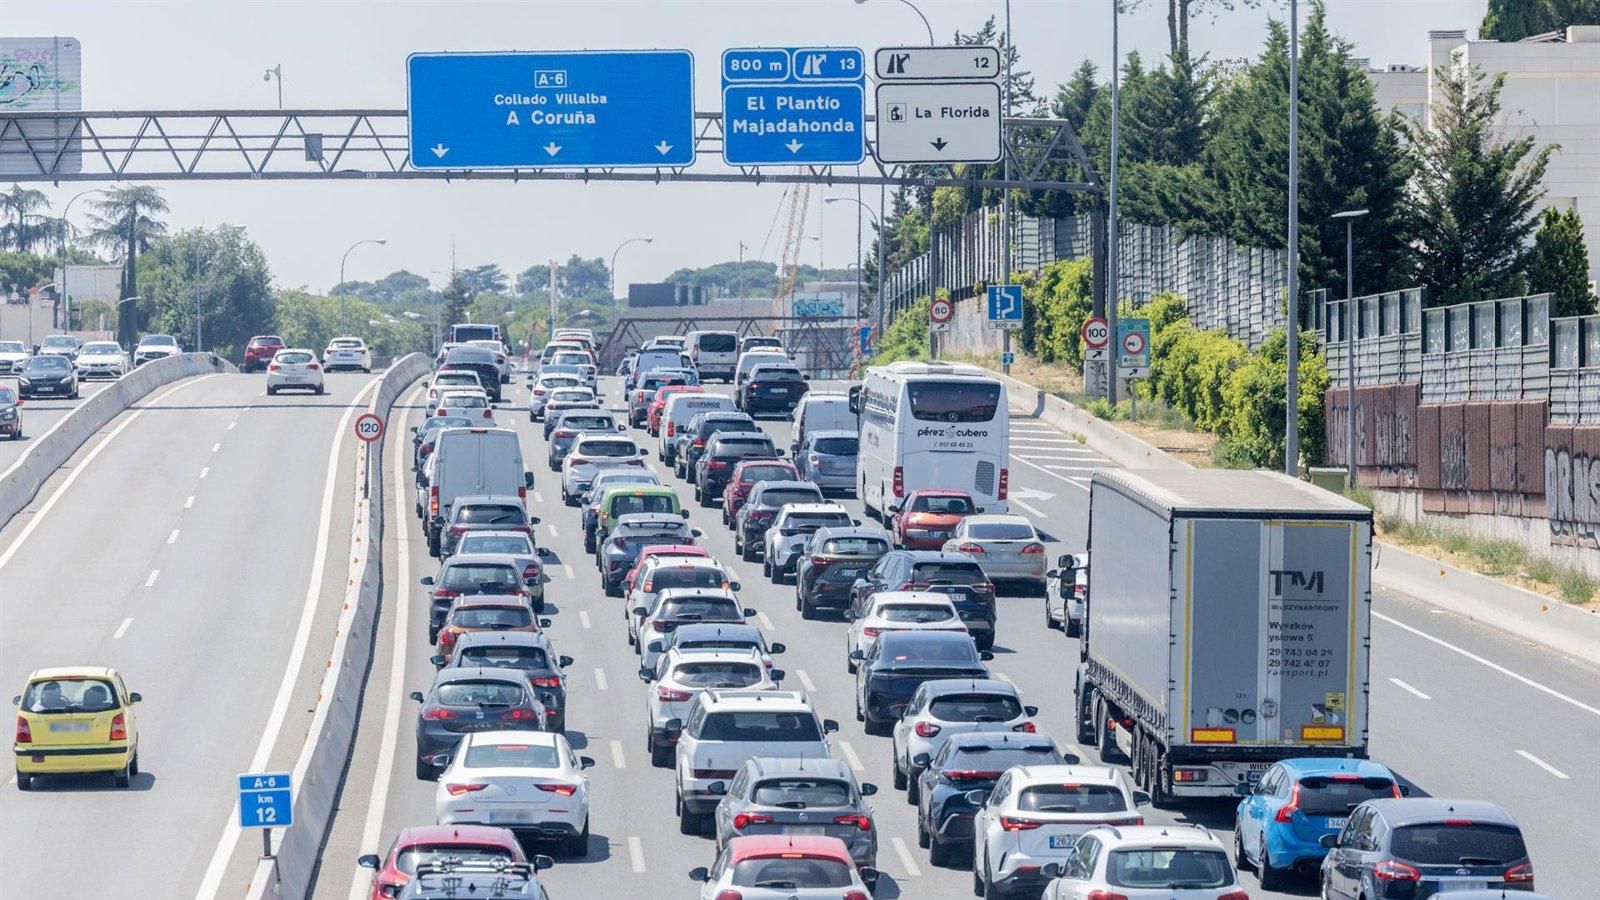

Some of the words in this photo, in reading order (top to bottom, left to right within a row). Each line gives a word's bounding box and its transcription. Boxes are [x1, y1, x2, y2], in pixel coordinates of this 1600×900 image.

[731, 59, 762, 71] 800
[769, 62, 782, 71] m
[840, 58, 855, 70] 13
[974, 57, 989, 68] 12
[538, 73, 564, 85] A-6
[494, 94, 547, 105] Collado
[555, 93, 607, 105] Villalba
[747, 96, 765, 111] El
[776, 95, 840, 110] Plantío
[506, 111, 519, 125] A
[531, 110, 595, 125] Coruña
[915, 107, 932, 119] La
[941, 106, 990, 119] Florida
[733, 118, 855, 136] Majadahonda
[935, 306, 947, 314] 80
[1088, 328, 1107, 338] 100
[360, 423, 378, 432] 120
[917, 427, 944, 437] pérez
[956, 429, 988, 437] cubero
[1269, 648, 1280, 656] 29
[1284, 648, 1303, 656] 743
[1269, 659, 1280, 667] 29
[254, 777, 276, 788] A-6
[258, 794, 273, 803] km
[256, 807, 276, 822] 12
